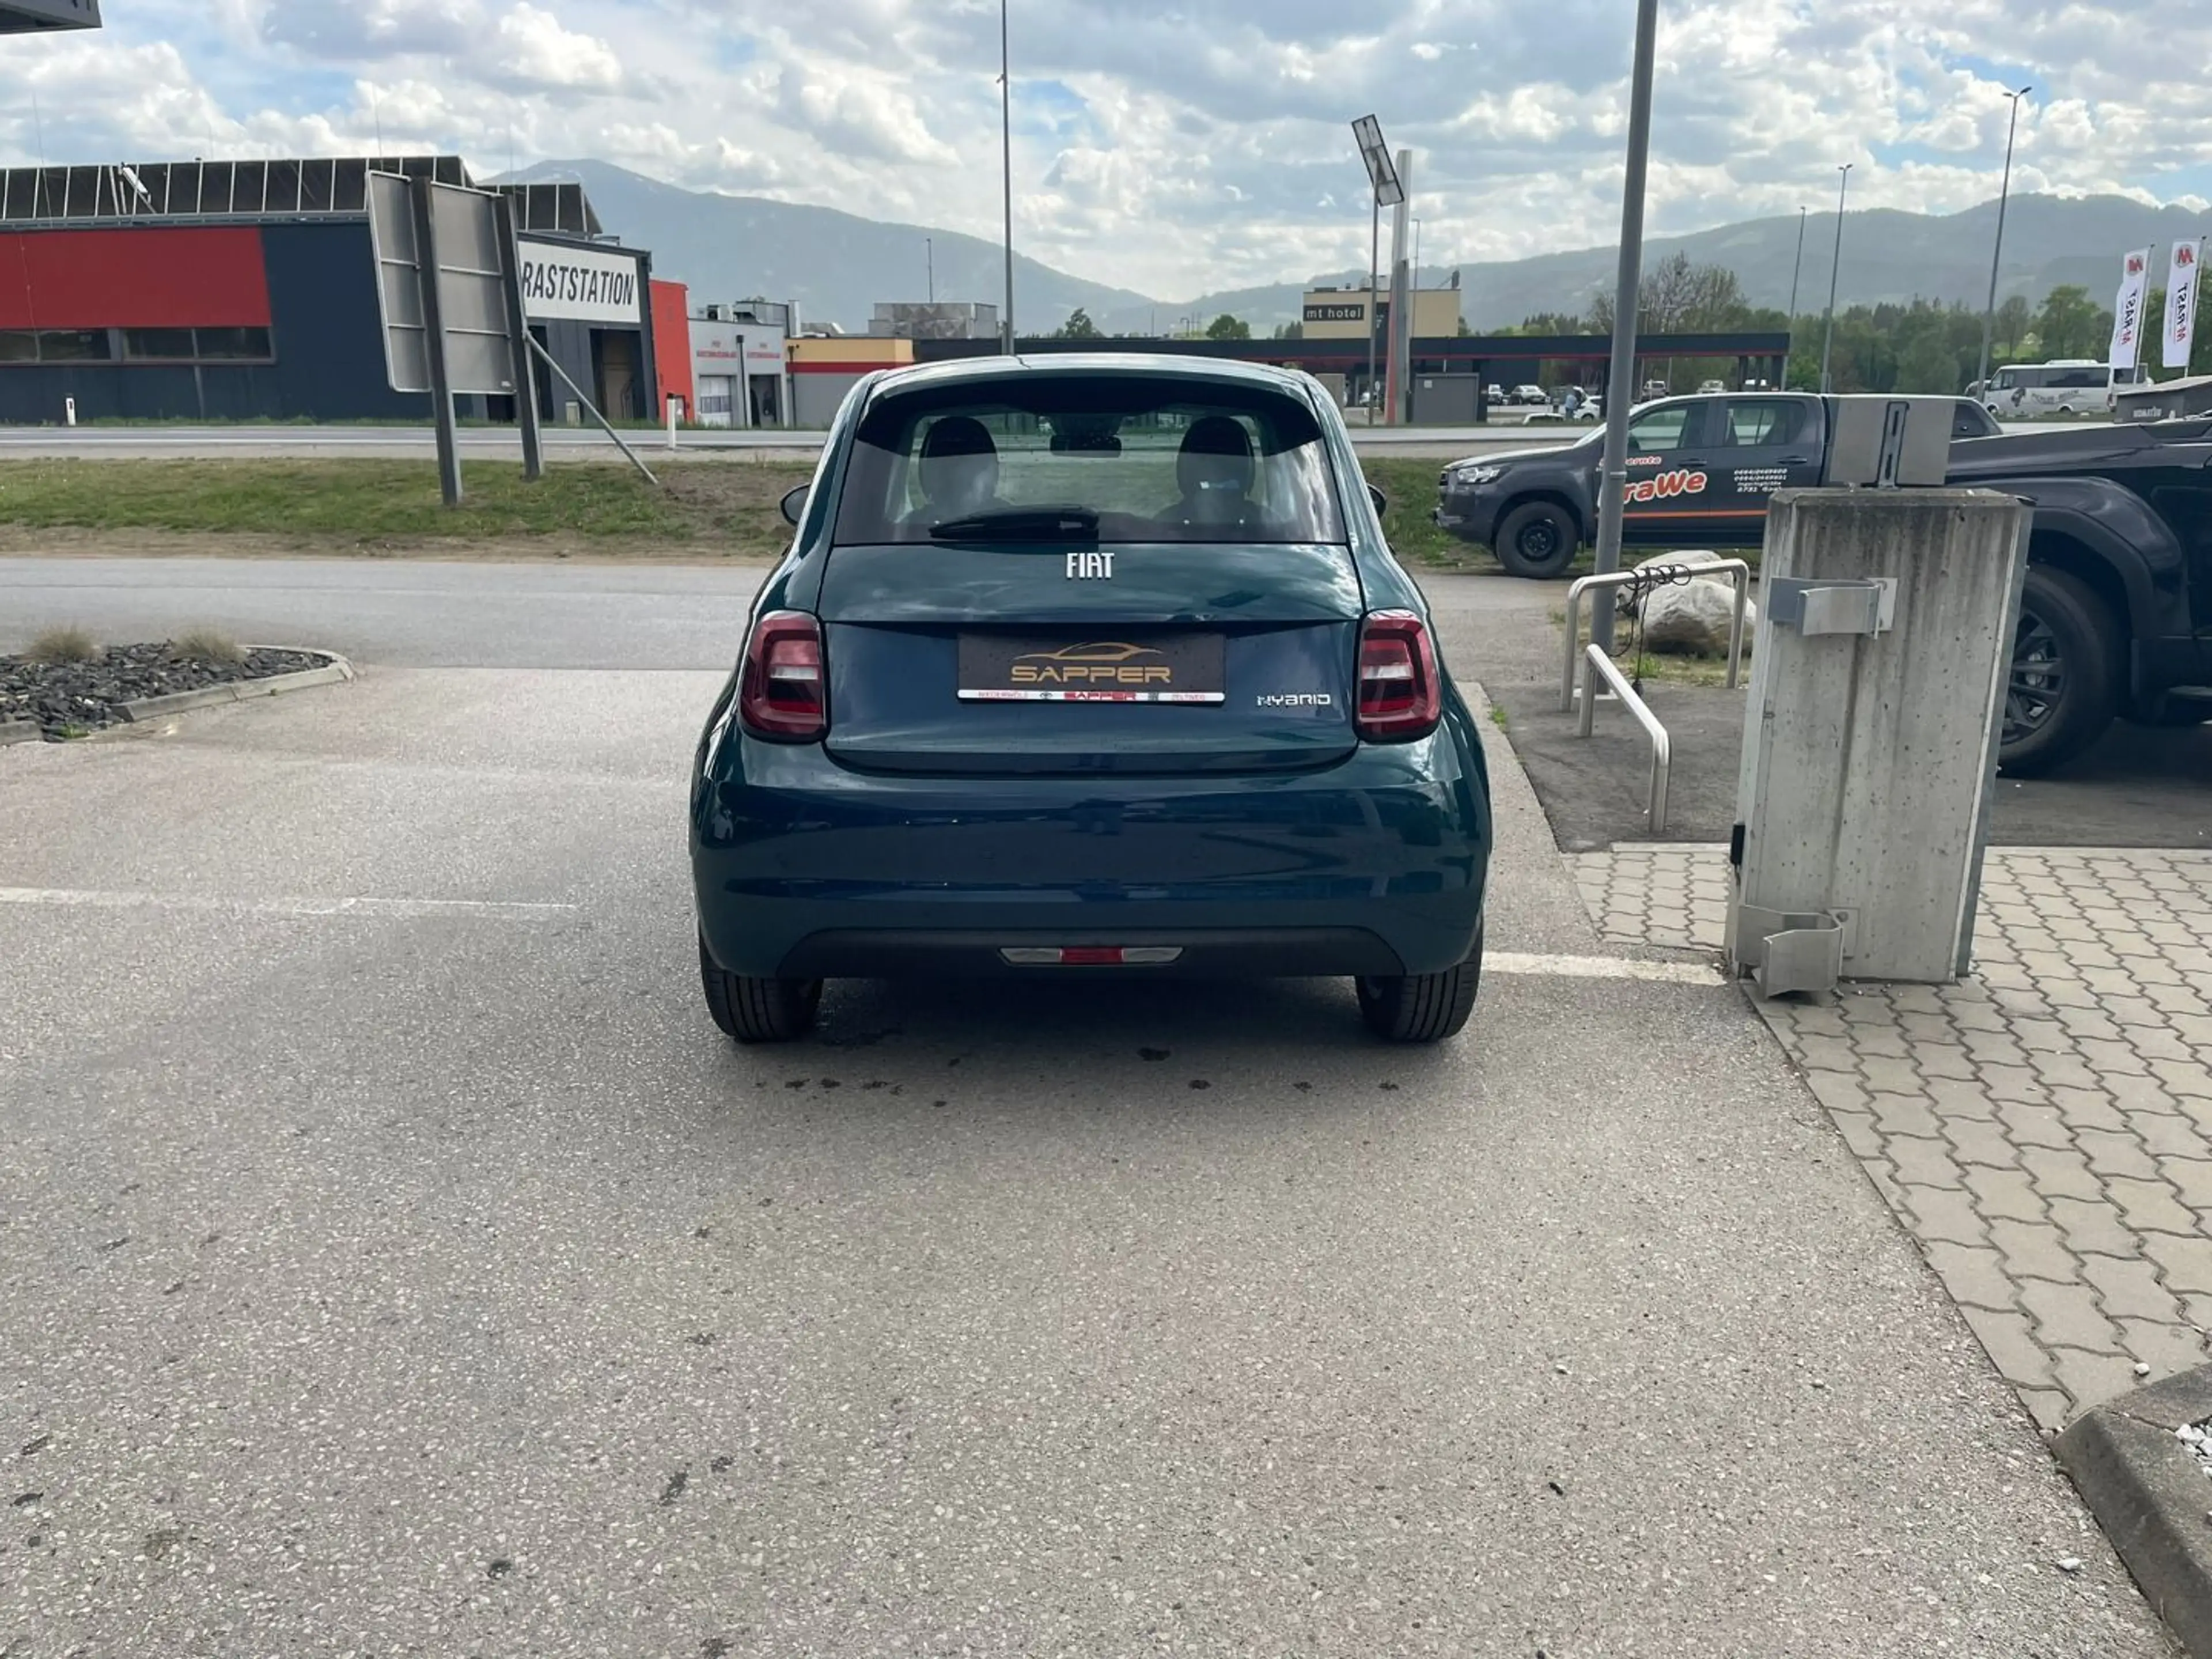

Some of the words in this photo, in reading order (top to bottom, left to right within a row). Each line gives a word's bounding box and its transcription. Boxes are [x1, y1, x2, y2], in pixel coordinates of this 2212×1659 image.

[522, 261, 635, 305] RASTSTATION
[1306, 308, 1322, 319] mt
[1328, 307, 1361, 319] hotel
[1598, 469, 1707, 507] raWe
[1067, 552, 1115, 578] FIAT
[1010, 665, 1171, 684] SAPPER
[1063, 691, 1137, 700] SAPPER
[1256, 694, 1331, 706] HYBRID
